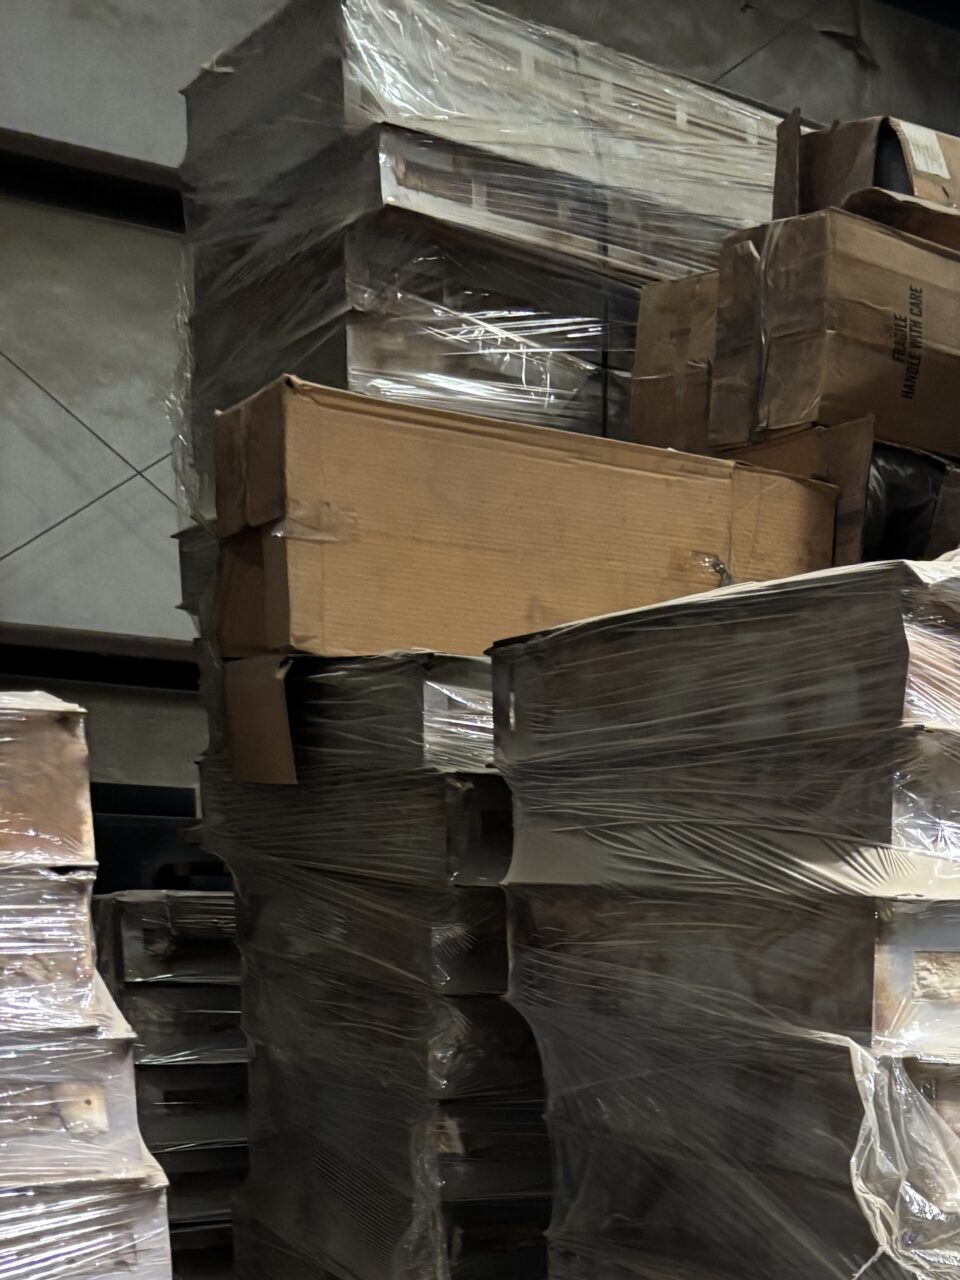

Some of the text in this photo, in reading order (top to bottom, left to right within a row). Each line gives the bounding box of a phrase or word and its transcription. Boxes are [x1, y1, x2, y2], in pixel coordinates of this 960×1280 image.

[893, 312, 907, 362] FRAGILE
[901, 284, 923, 400] HANDLE WITH CARE
